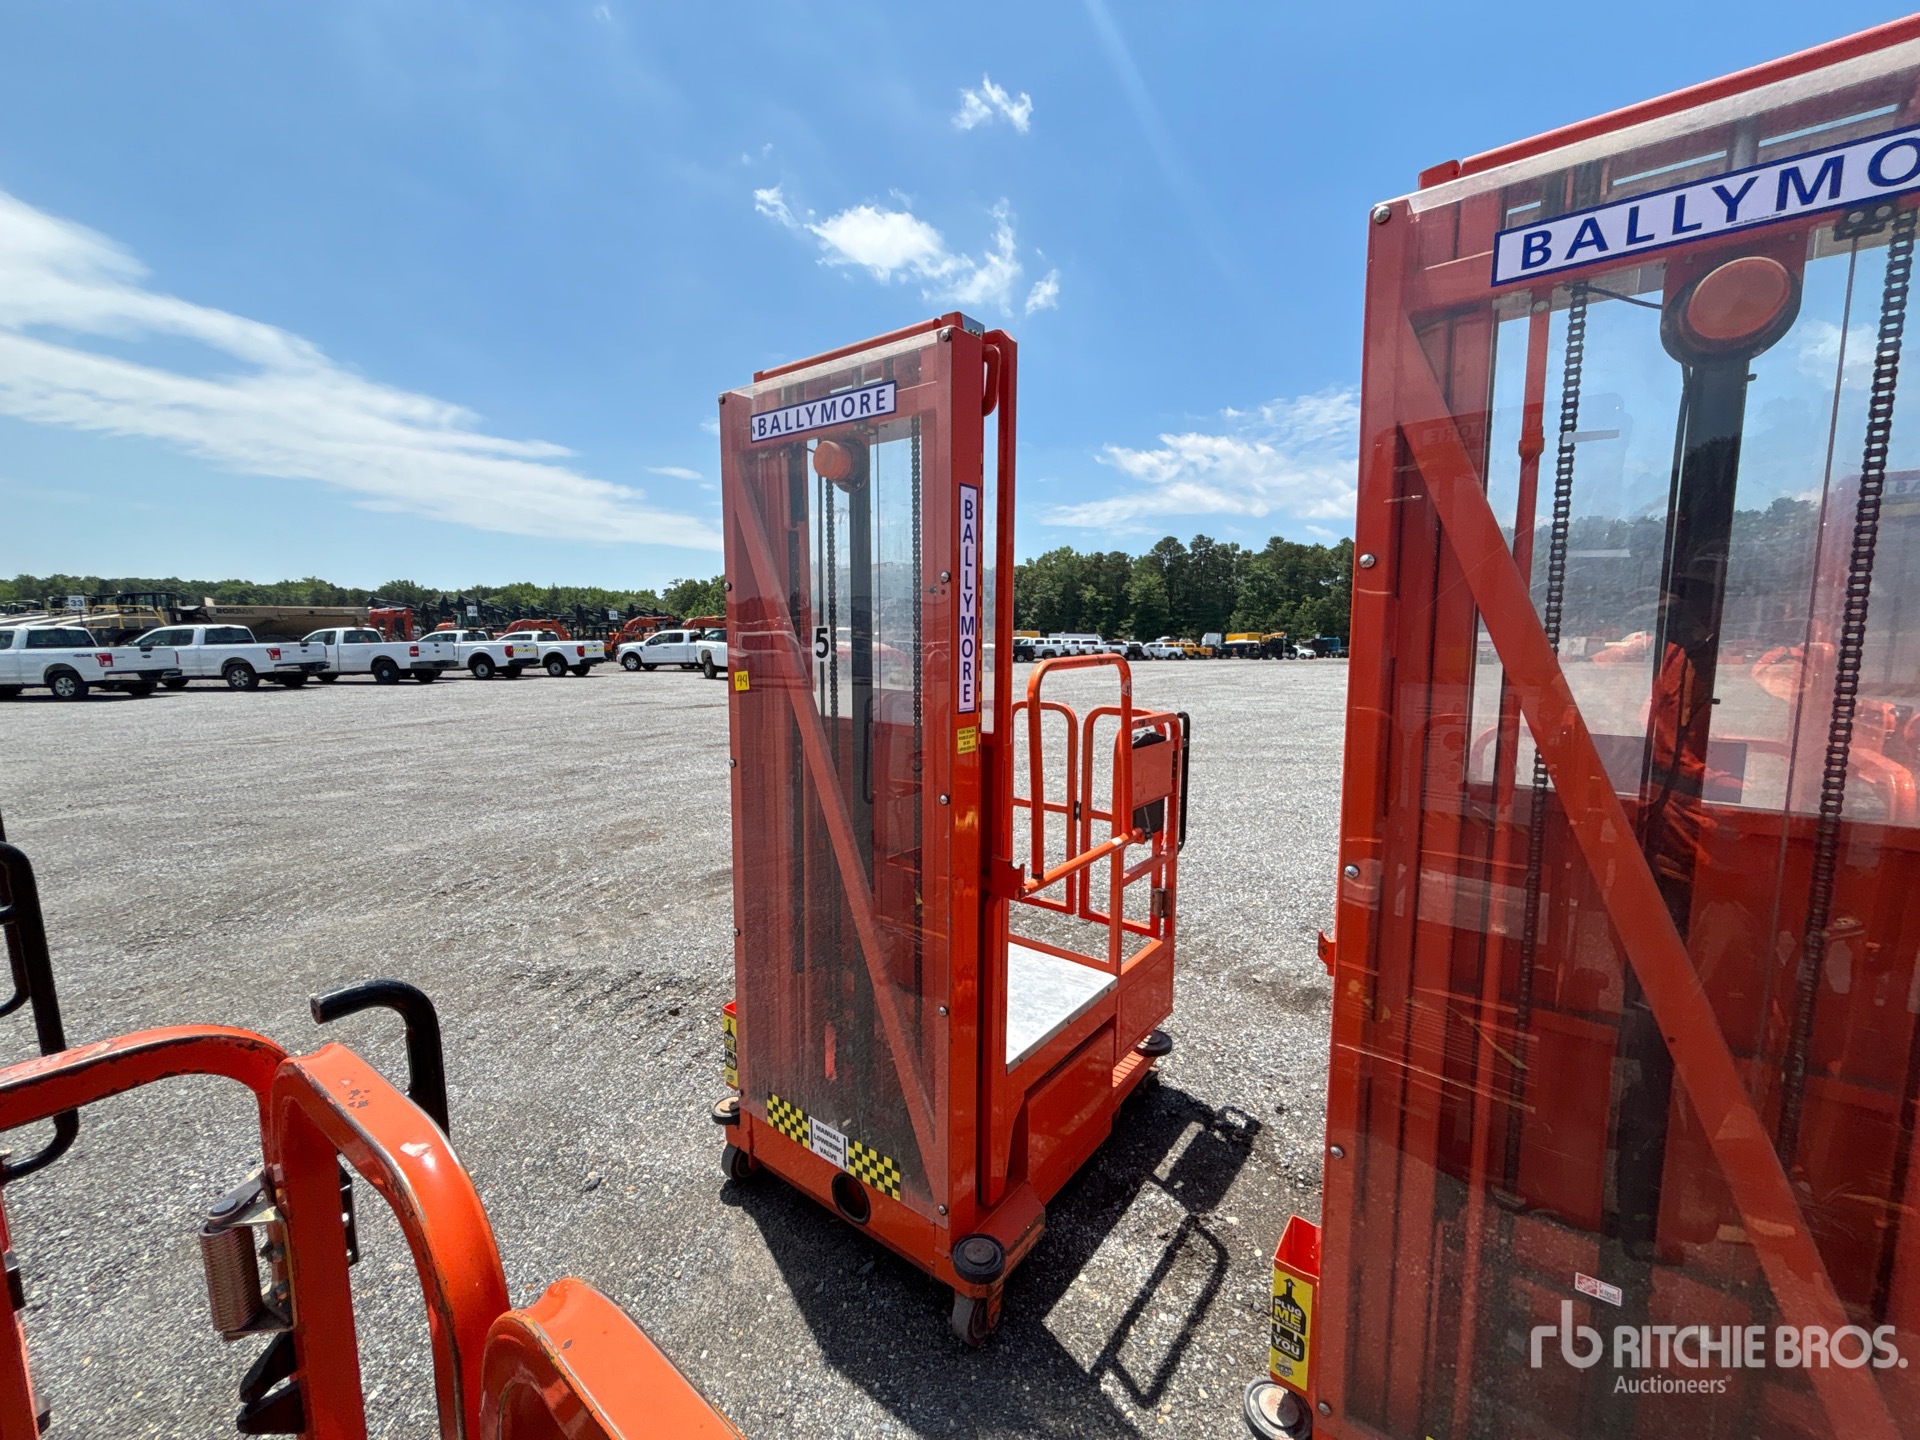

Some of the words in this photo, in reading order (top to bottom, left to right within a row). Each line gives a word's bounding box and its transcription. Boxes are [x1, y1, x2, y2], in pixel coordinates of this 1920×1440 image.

[758, 387, 887, 438] BALLYMORE
[70, 599, 84, 607] 33
[960, 499, 975, 703] BALLYMORE
[815, 627, 829, 659] 5
[814, 1133, 843, 1155] LOWERING
[815, 1124, 840, 1143] MANUAL
[819, 1146, 838, 1162] VALVE
[1274, 1297, 1302, 1317] PLUG
[1274, 1306, 1301, 1327] ME
[1273, 1335, 1300, 1356] YOU
